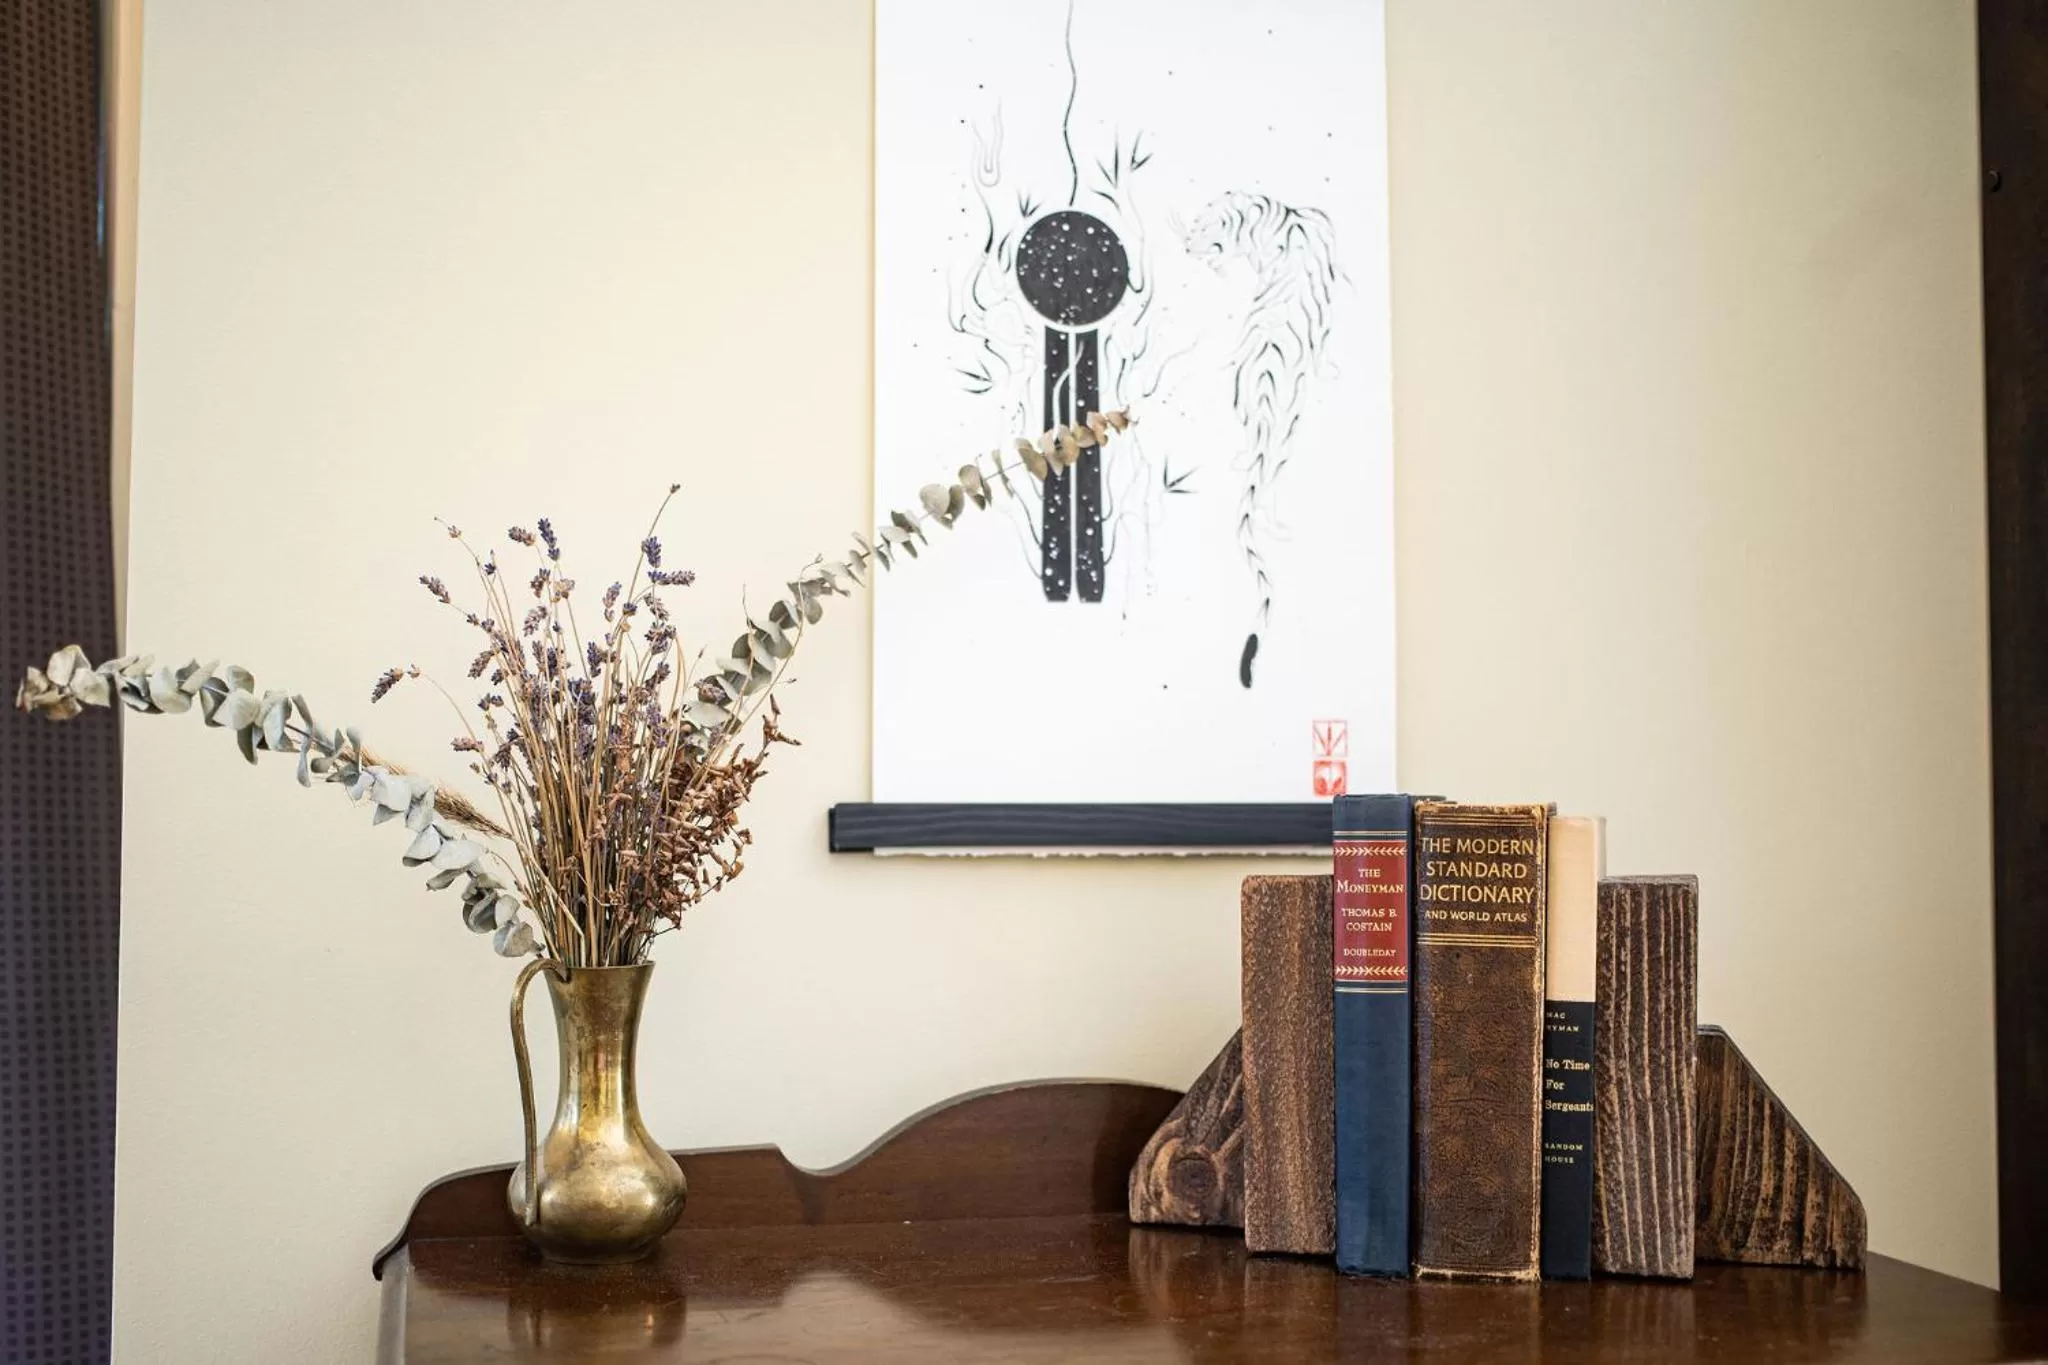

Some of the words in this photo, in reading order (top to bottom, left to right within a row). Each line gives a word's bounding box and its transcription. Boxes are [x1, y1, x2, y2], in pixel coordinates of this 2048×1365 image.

[1419, 837, 1450, 854] THE
[1456, 838, 1535, 855] MODERN
[1358, 868, 1381, 878] THE
[1426, 860, 1528, 879] STANDARD
[1420, 884, 1535, 904] DICTIONARY
[1341, 908, 1385, 918] THOMAS
[1424, 910, 1447, 920] AND
[1450, 911, 1490, 922] WORLD
[1494, 912, 1528, 922] ATLAS
[1346, 922, 1392, 932] COSTAIN
[1343, 948, 1396, 956] DOUBLEDAY
[1545, 1058, 1560, 1068] No
[1562, 1059, 1590, 1070] Time
[1546, 1079, 1566, 1090] For
